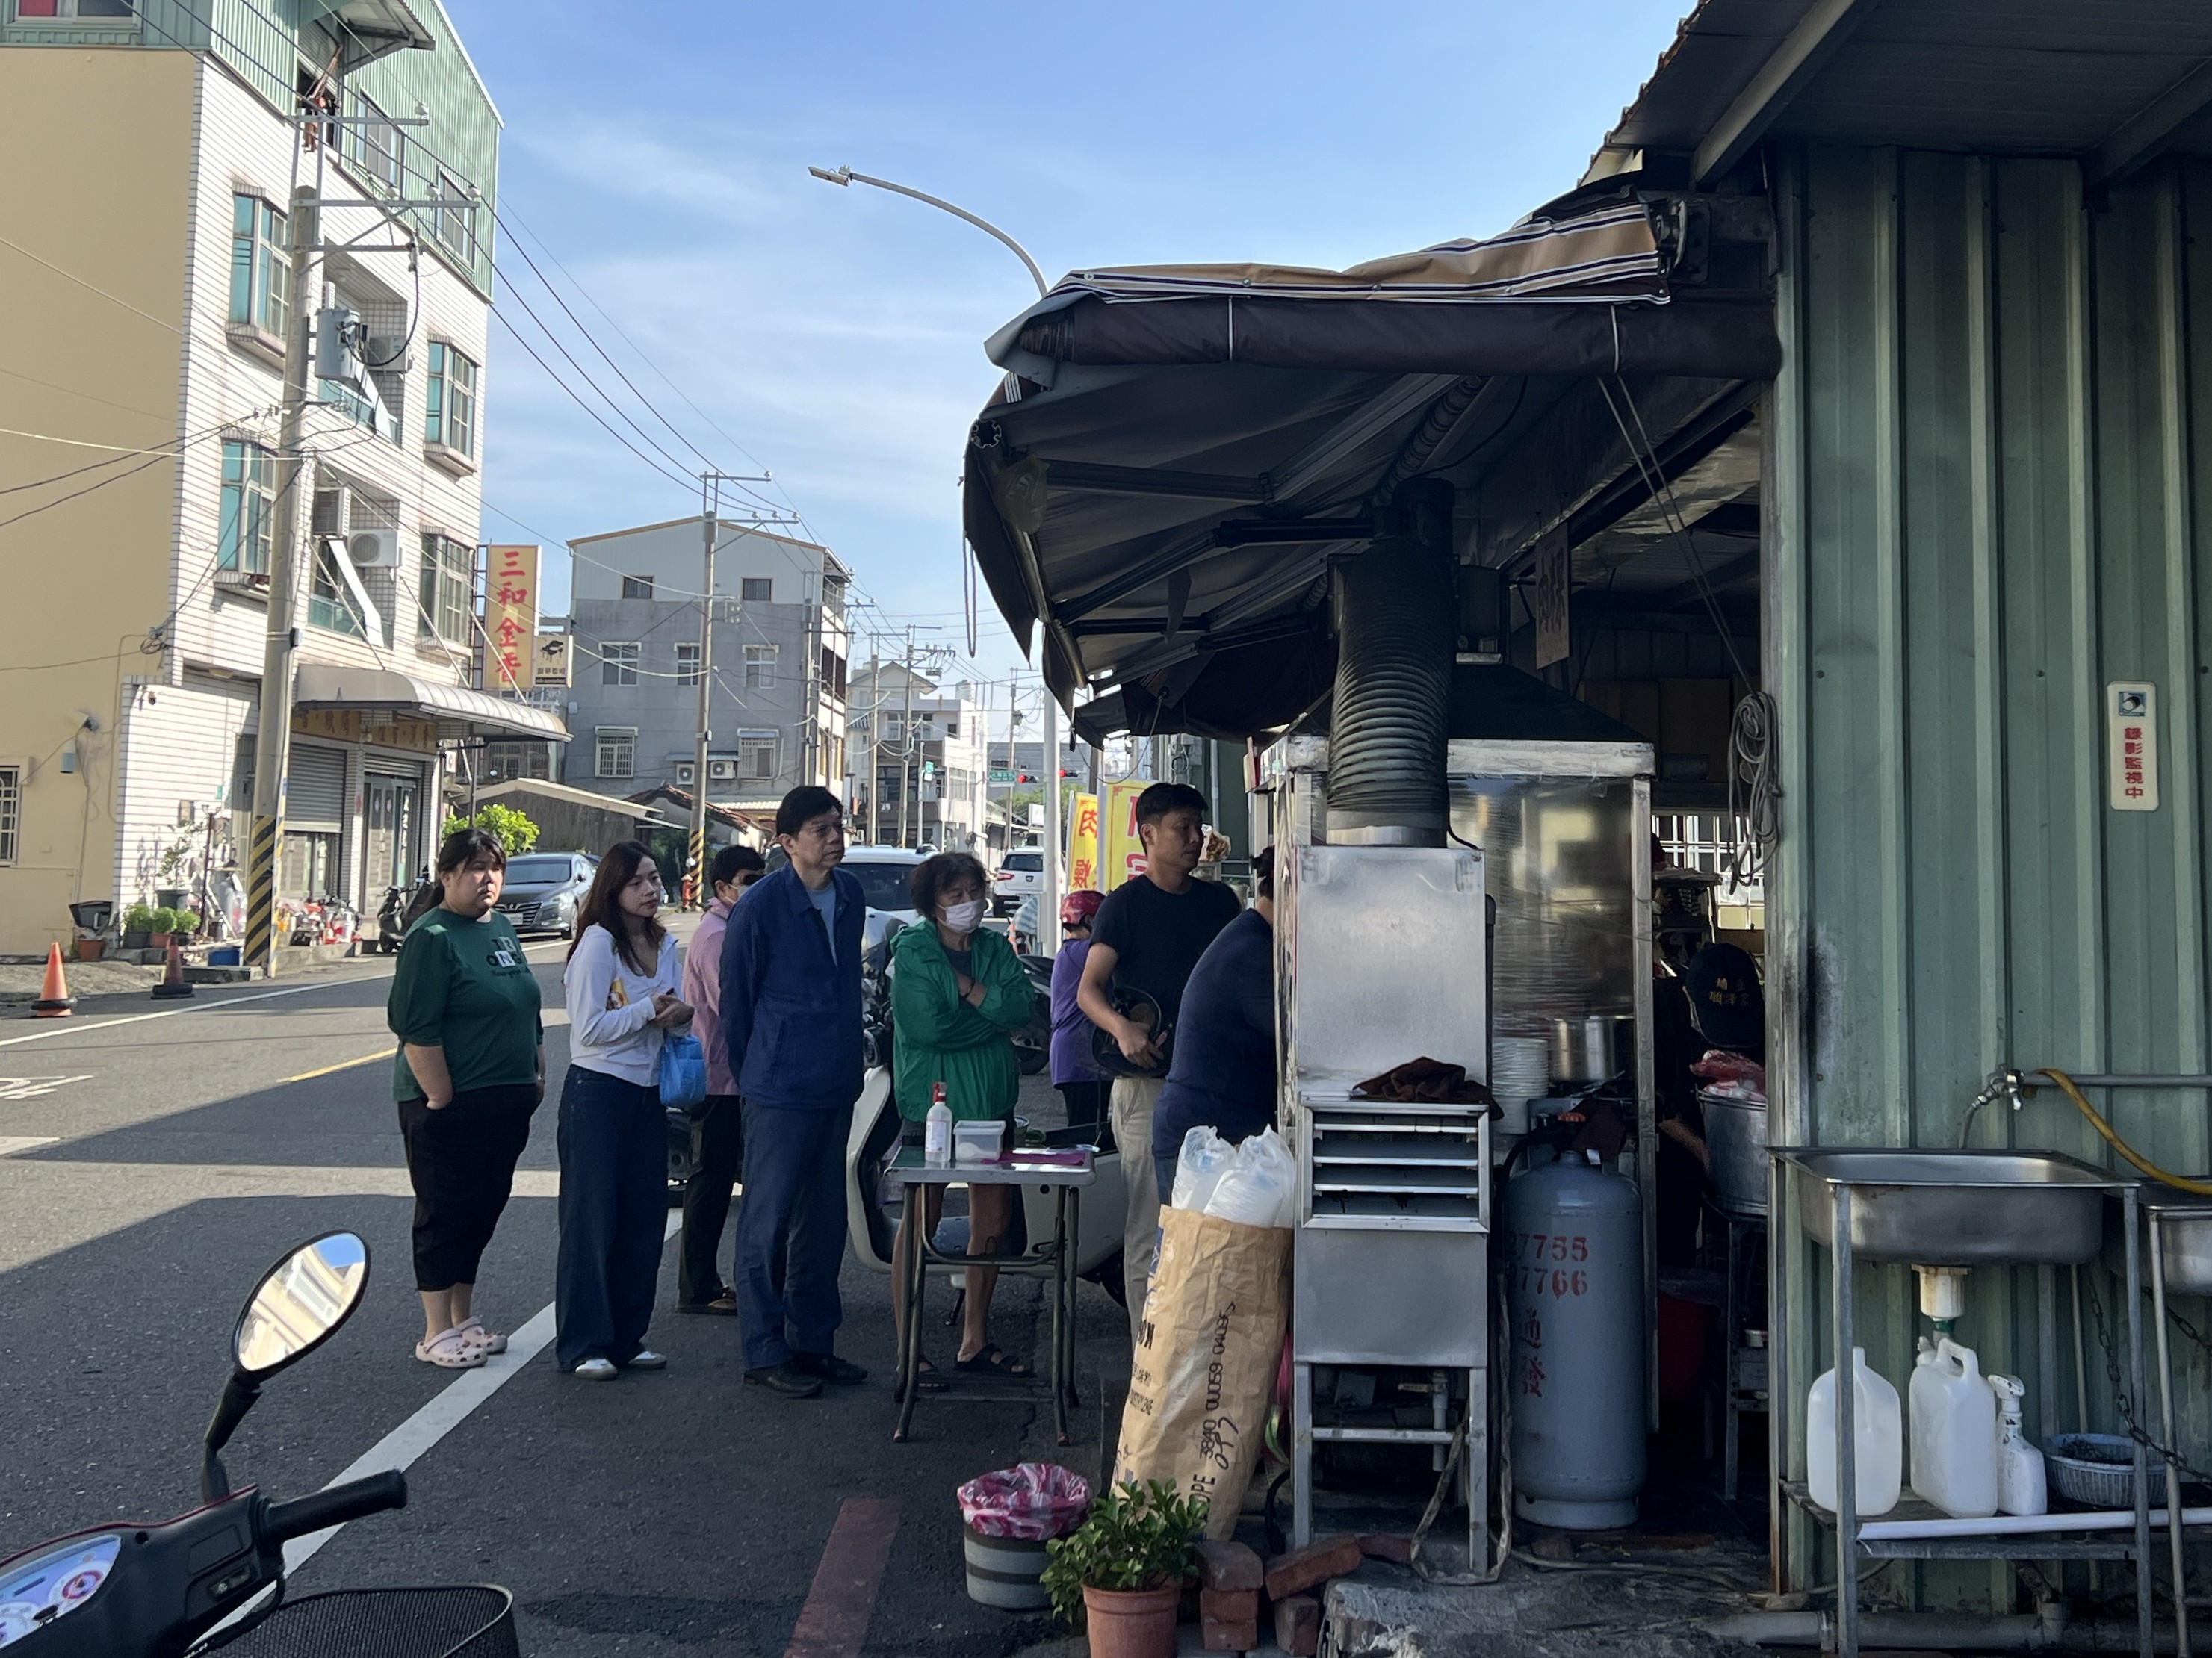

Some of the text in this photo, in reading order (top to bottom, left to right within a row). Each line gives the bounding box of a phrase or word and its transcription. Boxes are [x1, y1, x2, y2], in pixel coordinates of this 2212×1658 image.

[495, 551, 527, 682] 三和金香
[2124, 727, 2143, 799] 錄影監視中
